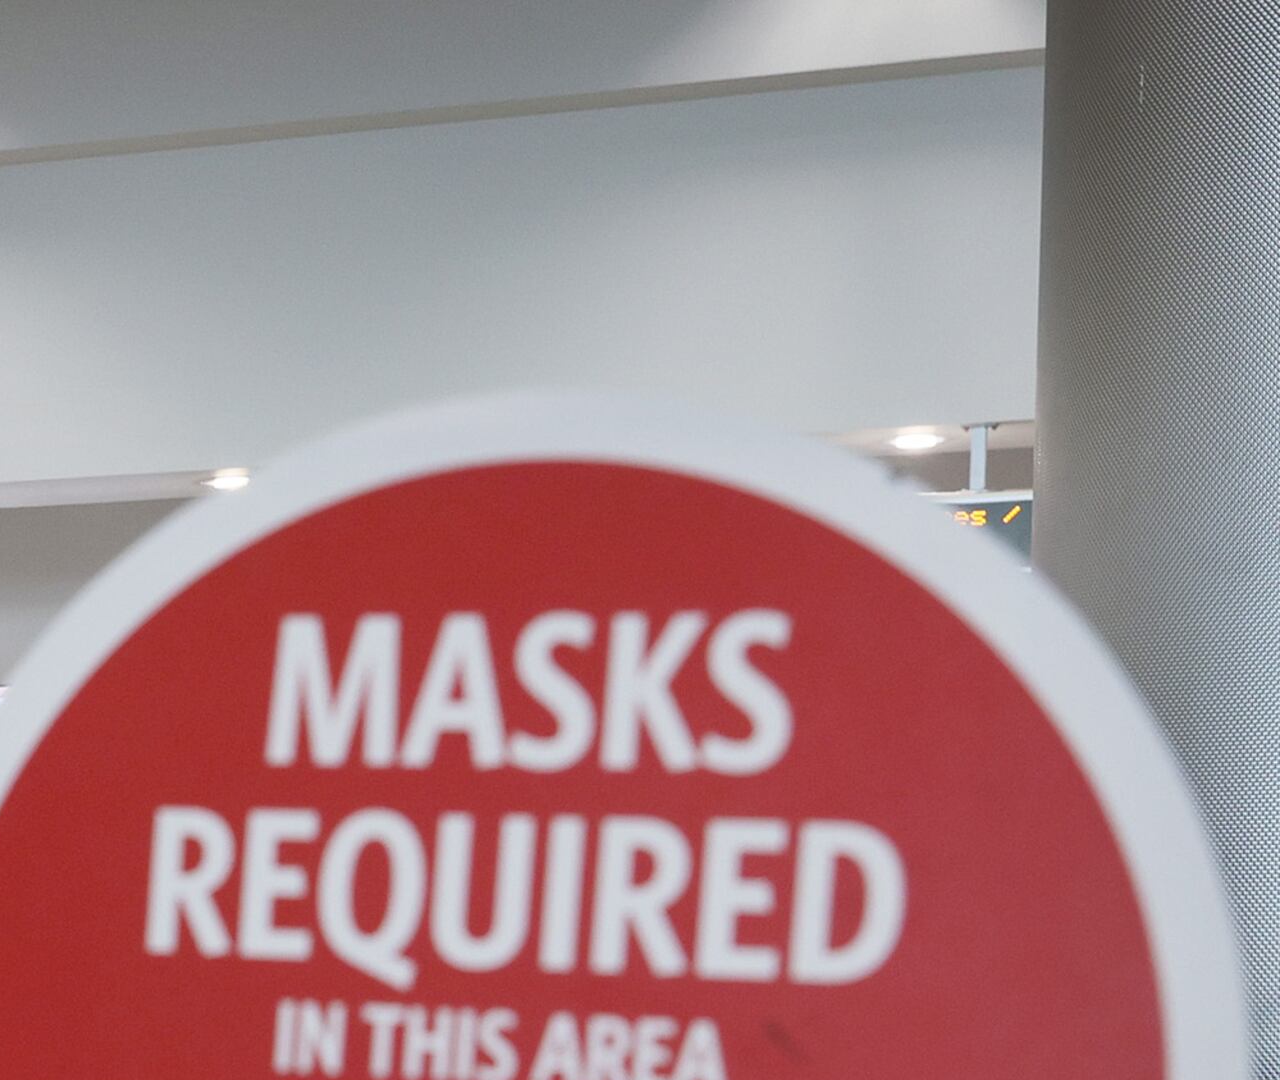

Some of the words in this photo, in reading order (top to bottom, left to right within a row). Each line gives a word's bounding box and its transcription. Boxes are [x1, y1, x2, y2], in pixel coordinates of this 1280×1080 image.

[263, 607, 795, 775] MASKS
[143, 804, 908, 992] REQUIRED
[272, 998, 347, 1077] IN
